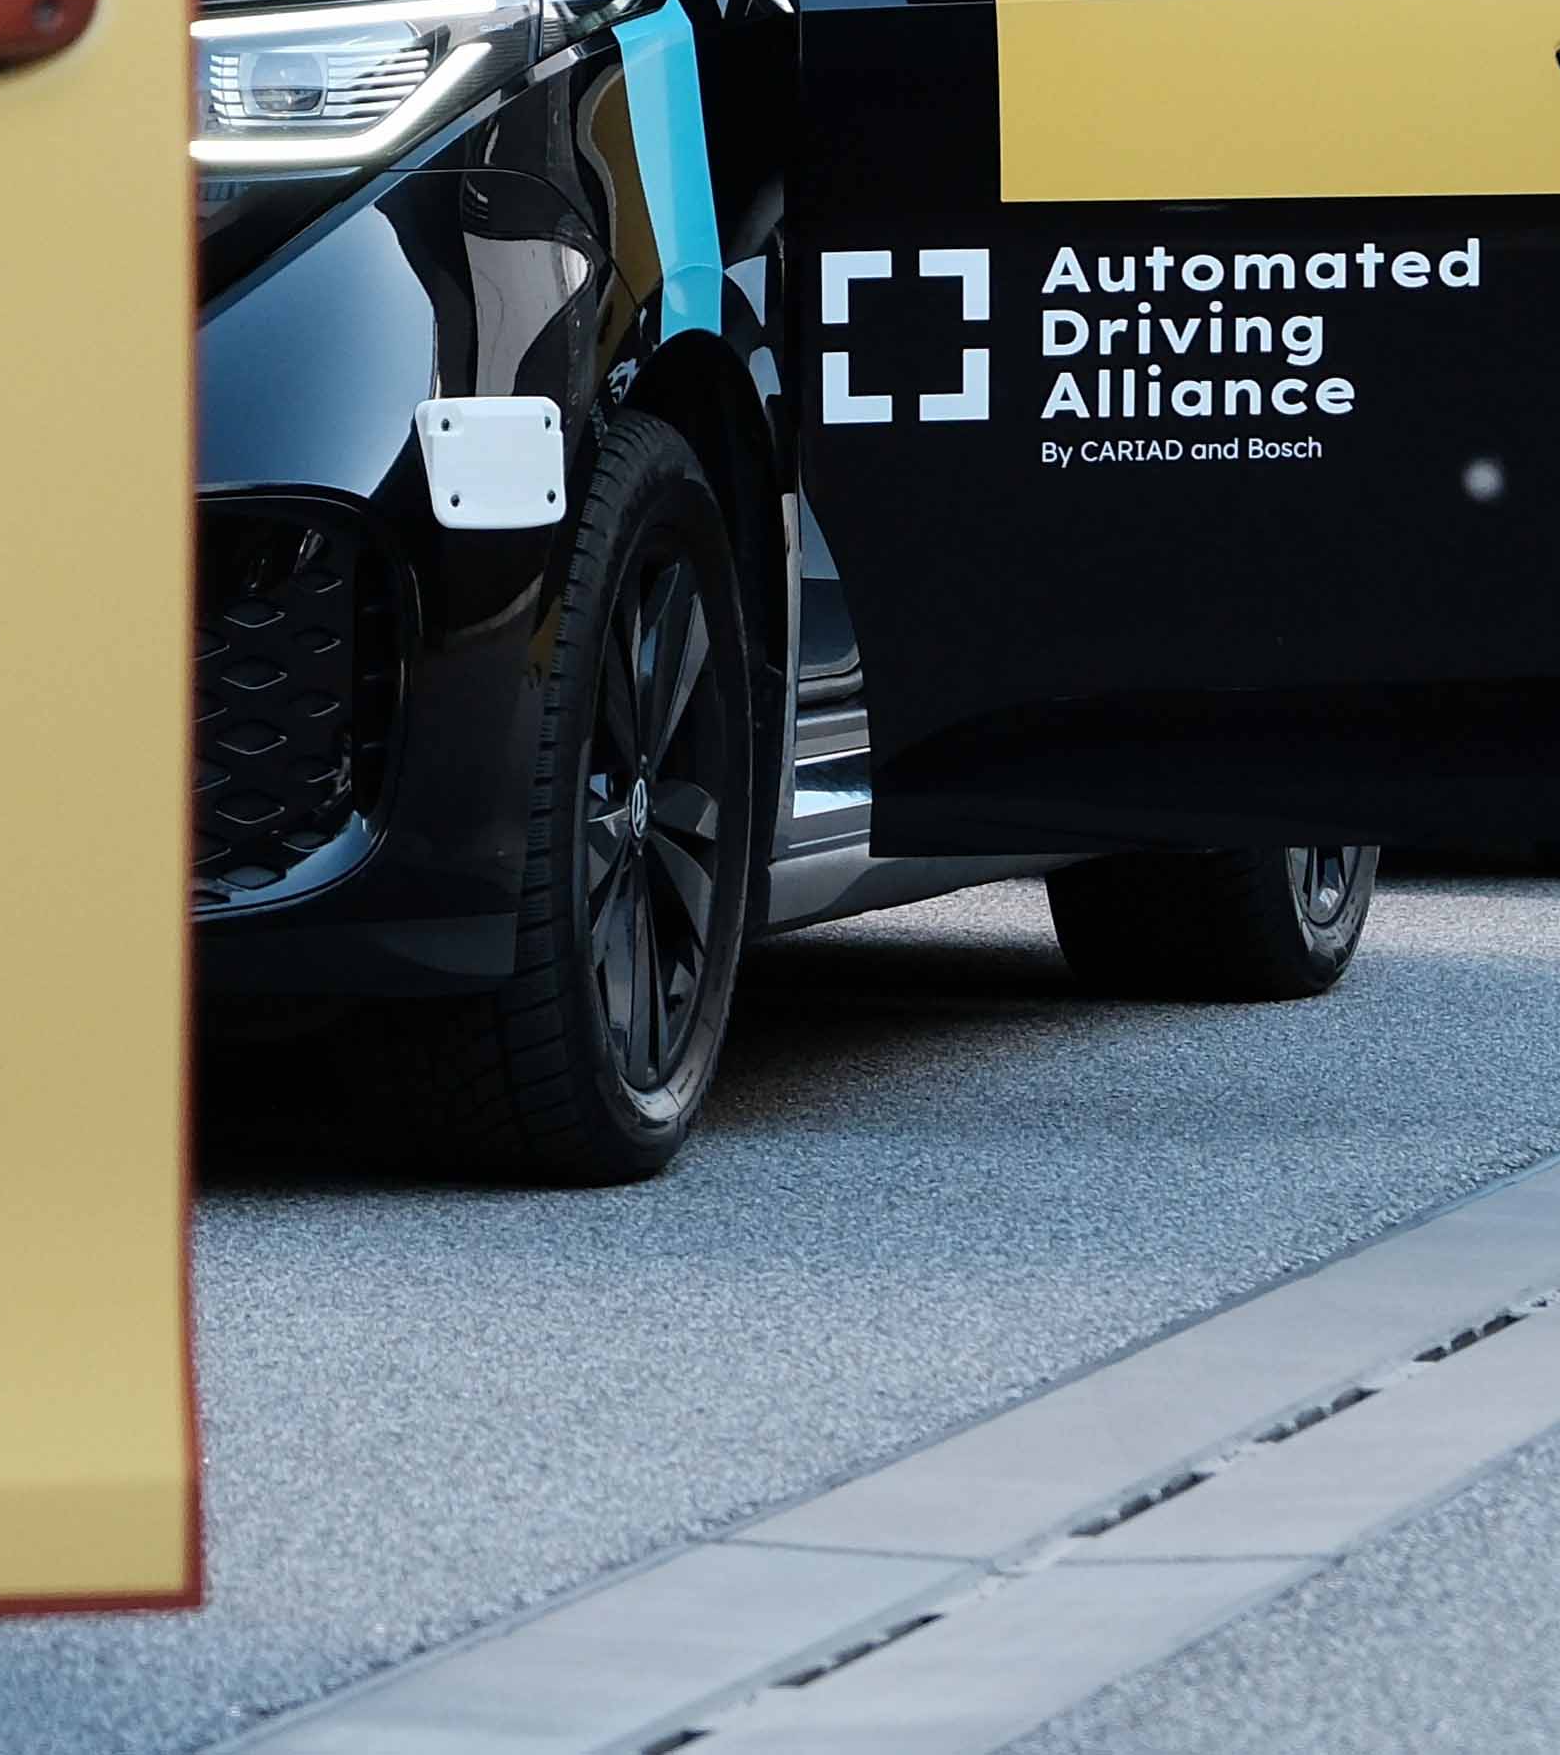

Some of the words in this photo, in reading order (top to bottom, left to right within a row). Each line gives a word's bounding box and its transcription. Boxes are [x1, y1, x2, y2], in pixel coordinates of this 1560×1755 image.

[1041, 237, 1483, 294] Automated
[1042, 301, 1324, 367] Driving
[1040, 364, 1356, 419] Alliance
[1041, 441, 1074, 469] By
[1080, 439, 1184, 462] CARIAD
[1190, 437, 1239, 461] and
[1248, 436, 1322, 459] Bosch
